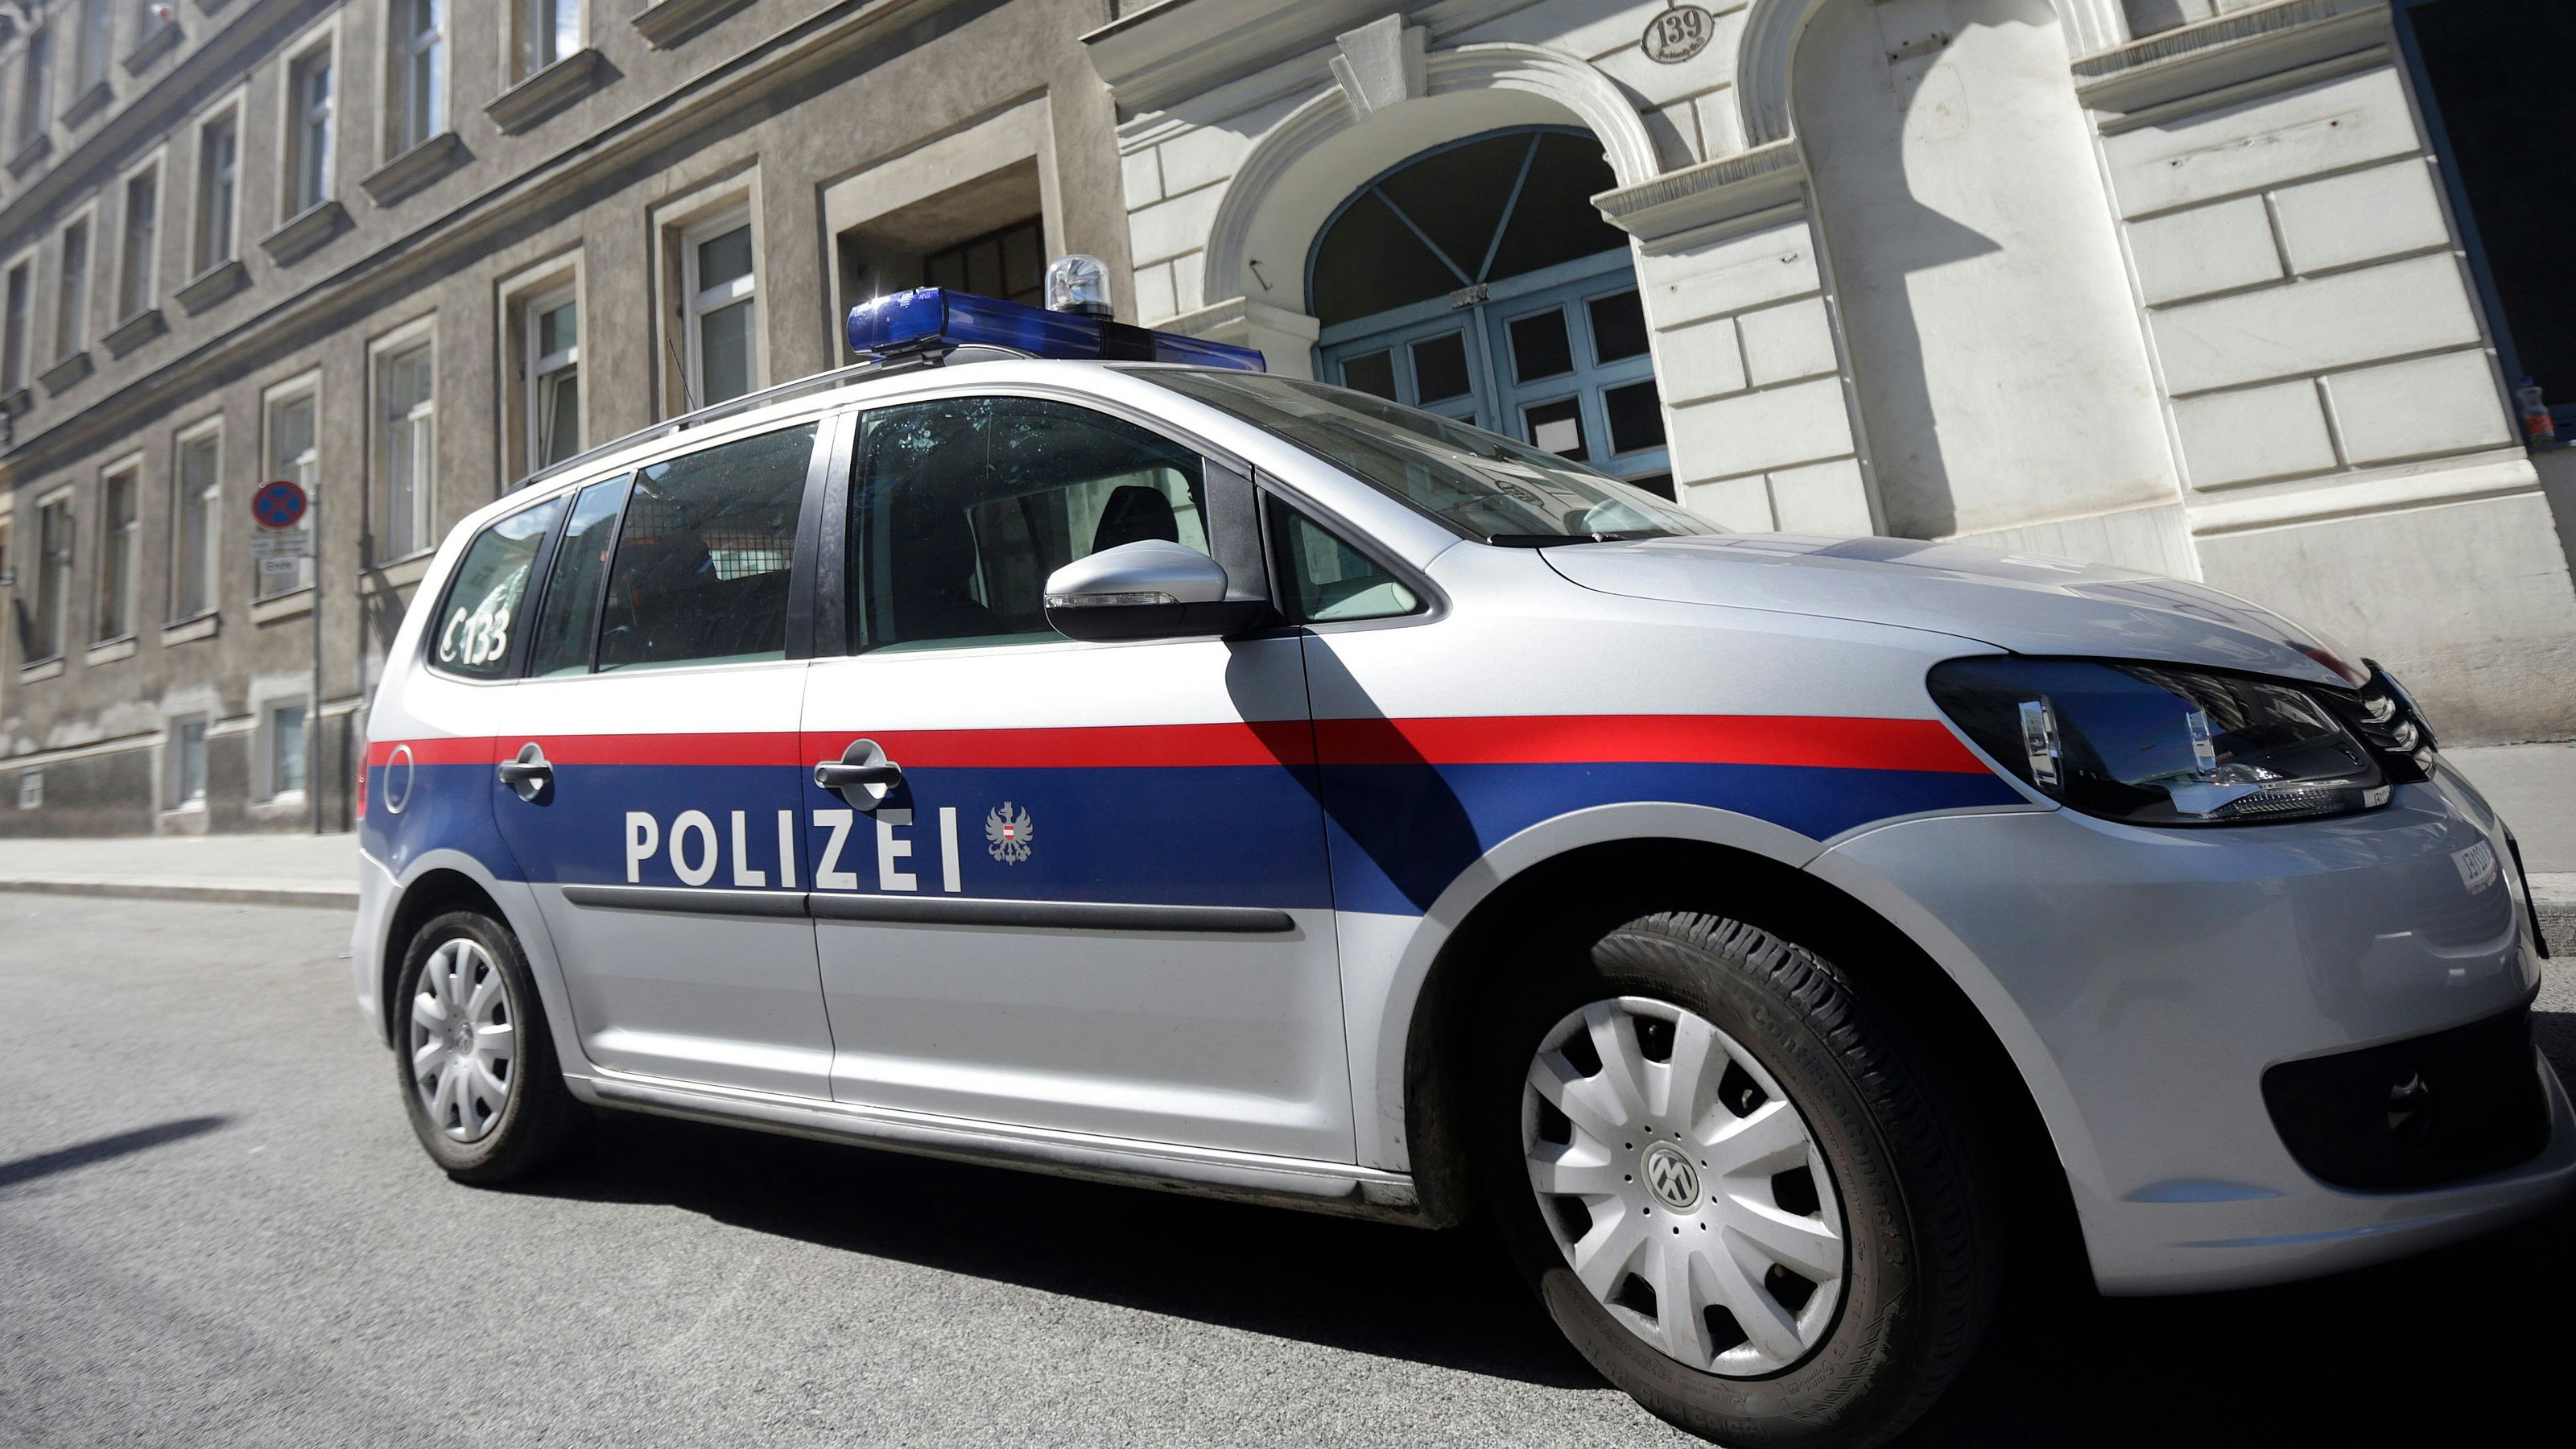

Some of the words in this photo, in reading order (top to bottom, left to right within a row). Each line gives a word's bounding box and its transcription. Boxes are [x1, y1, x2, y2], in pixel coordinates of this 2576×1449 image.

[1657, 10, 1703, 47] 139
[625, 807, 962, 893] POLIZEI
[1750, 1002, 1900, 1240] ContiEcoContact
